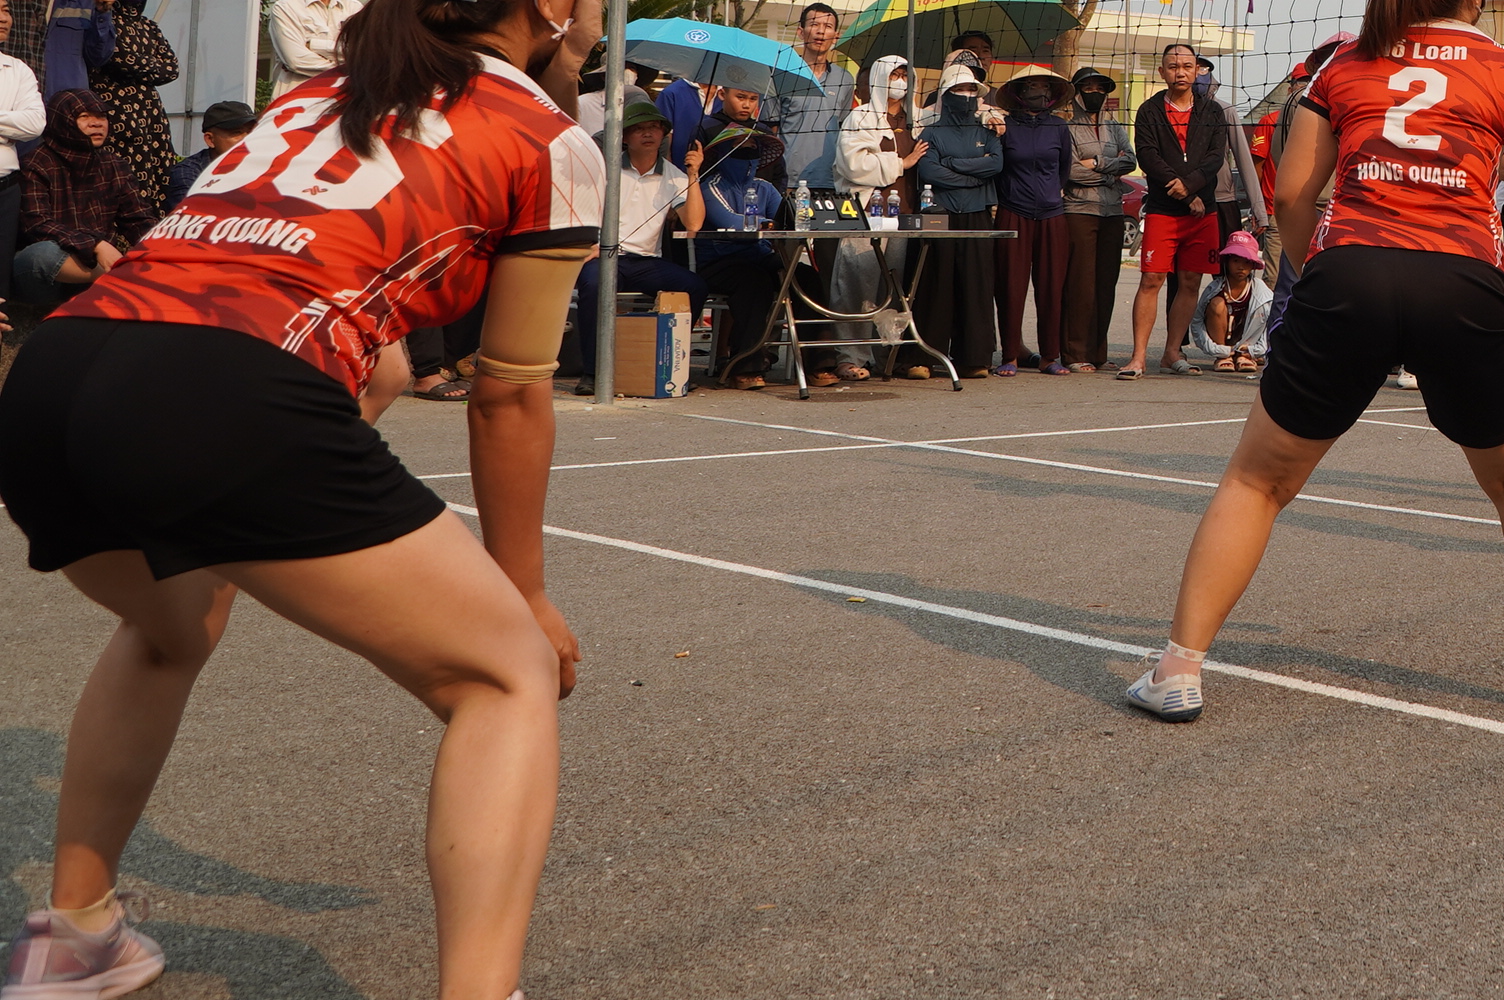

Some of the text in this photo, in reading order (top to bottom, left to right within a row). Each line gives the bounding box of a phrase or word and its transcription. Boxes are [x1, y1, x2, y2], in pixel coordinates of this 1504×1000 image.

[1412, 42, 1468, 60] Loan
[1382, 66, 1448, 151] 2
[1357, 156, 1467, 188] HỒNG QUANG
[841, 200, 858, 217] 4
[209, 216, 316, 254] QUANG
[674, 338, 682, 373] AQUAFINA
